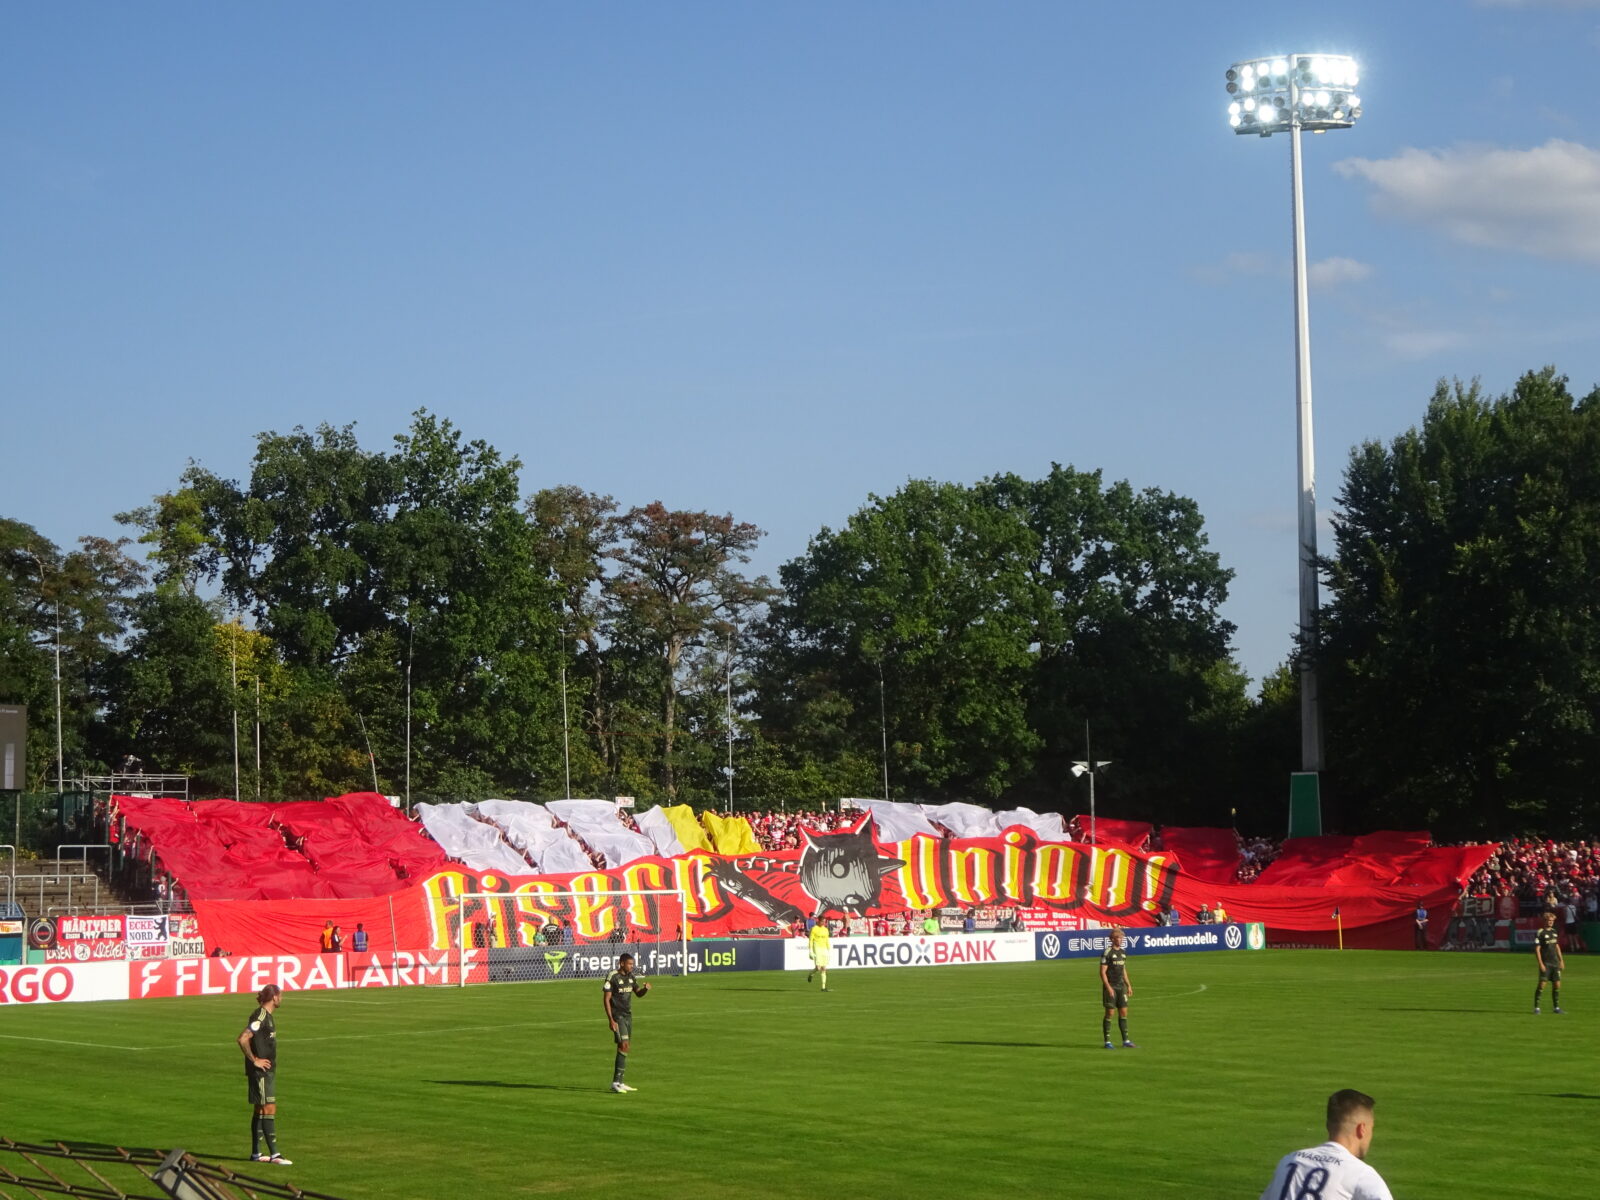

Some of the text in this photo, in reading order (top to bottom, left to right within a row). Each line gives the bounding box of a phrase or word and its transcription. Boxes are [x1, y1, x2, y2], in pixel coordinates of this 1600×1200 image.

[898, 831, 1166, 911] Union!
[62, 918, 121, 933] MÄRTYRER
[129, 921, 154, 930] ECKE
[129, 932, 153, 940] NORD
[1144, 932, 1218, 948] Sondermodelle
[172, 941, 205, 955] GOCKEL
[573, 953, 646, 973] freent,
[705, 948, 736, 966] los!
[175, 950, 449, 996] FLYERALARM
[1278, 1162, 1329, 1200] 18
